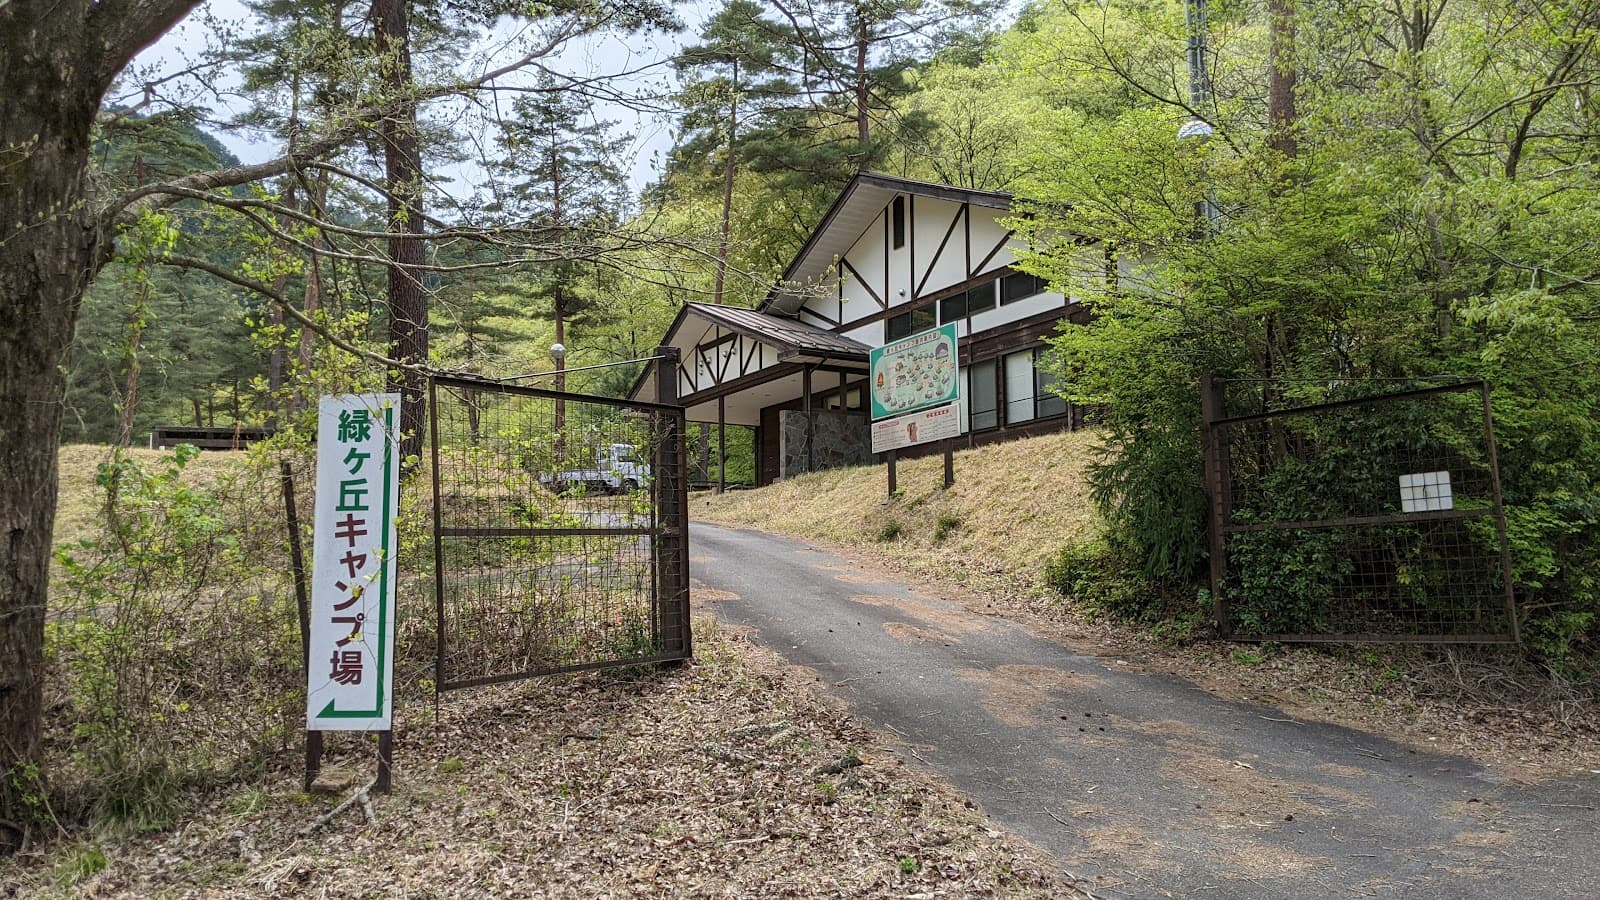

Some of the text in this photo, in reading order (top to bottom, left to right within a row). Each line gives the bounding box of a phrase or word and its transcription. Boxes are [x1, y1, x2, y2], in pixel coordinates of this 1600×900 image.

[328, 409, 372, 686] 緑ヶ丘キャンプ場
